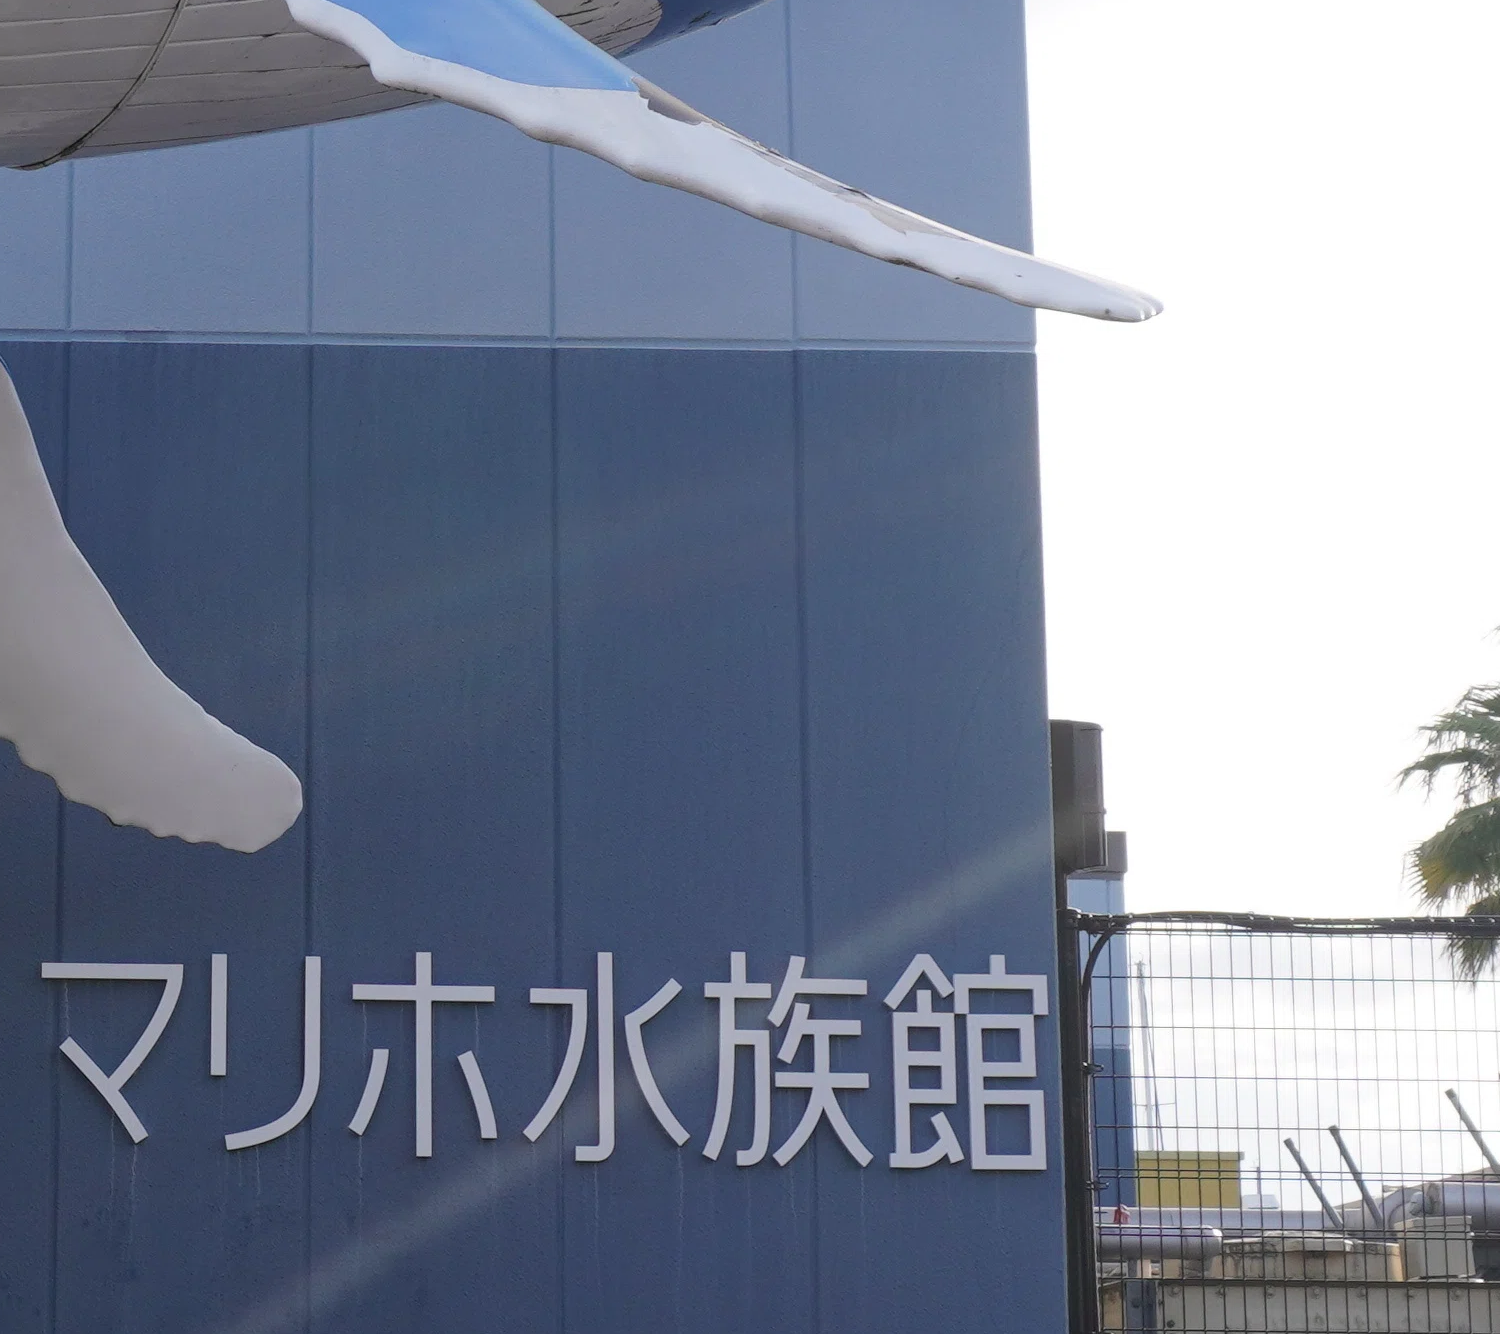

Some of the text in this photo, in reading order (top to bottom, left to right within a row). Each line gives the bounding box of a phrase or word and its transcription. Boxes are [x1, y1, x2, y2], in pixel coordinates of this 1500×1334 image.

[41, 952, 1048, 1172] マリホ水族館
